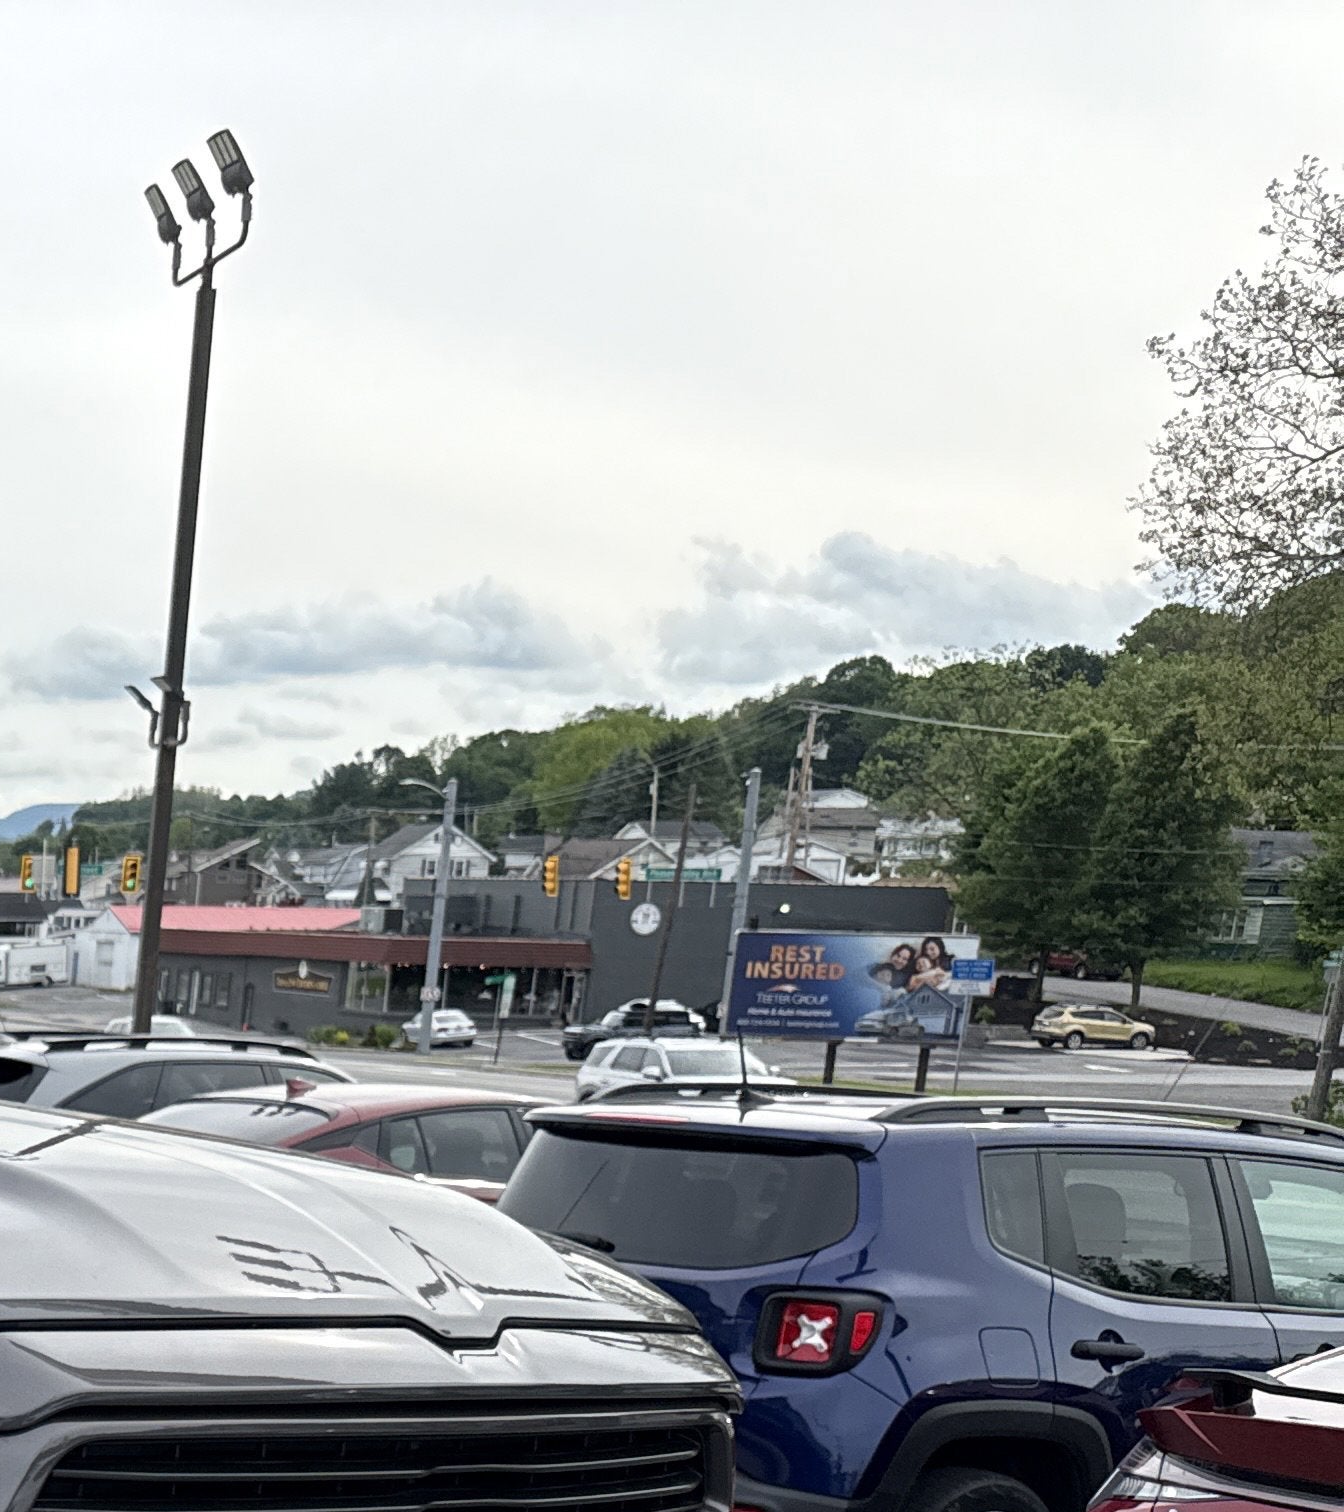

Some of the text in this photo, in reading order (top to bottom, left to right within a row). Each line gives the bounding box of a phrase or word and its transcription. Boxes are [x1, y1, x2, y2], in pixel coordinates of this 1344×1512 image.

[770, 944, 826, 963] REST
[745, 960, 846, 981] INSURED
[792, 993, 829, 1005] GROUP
